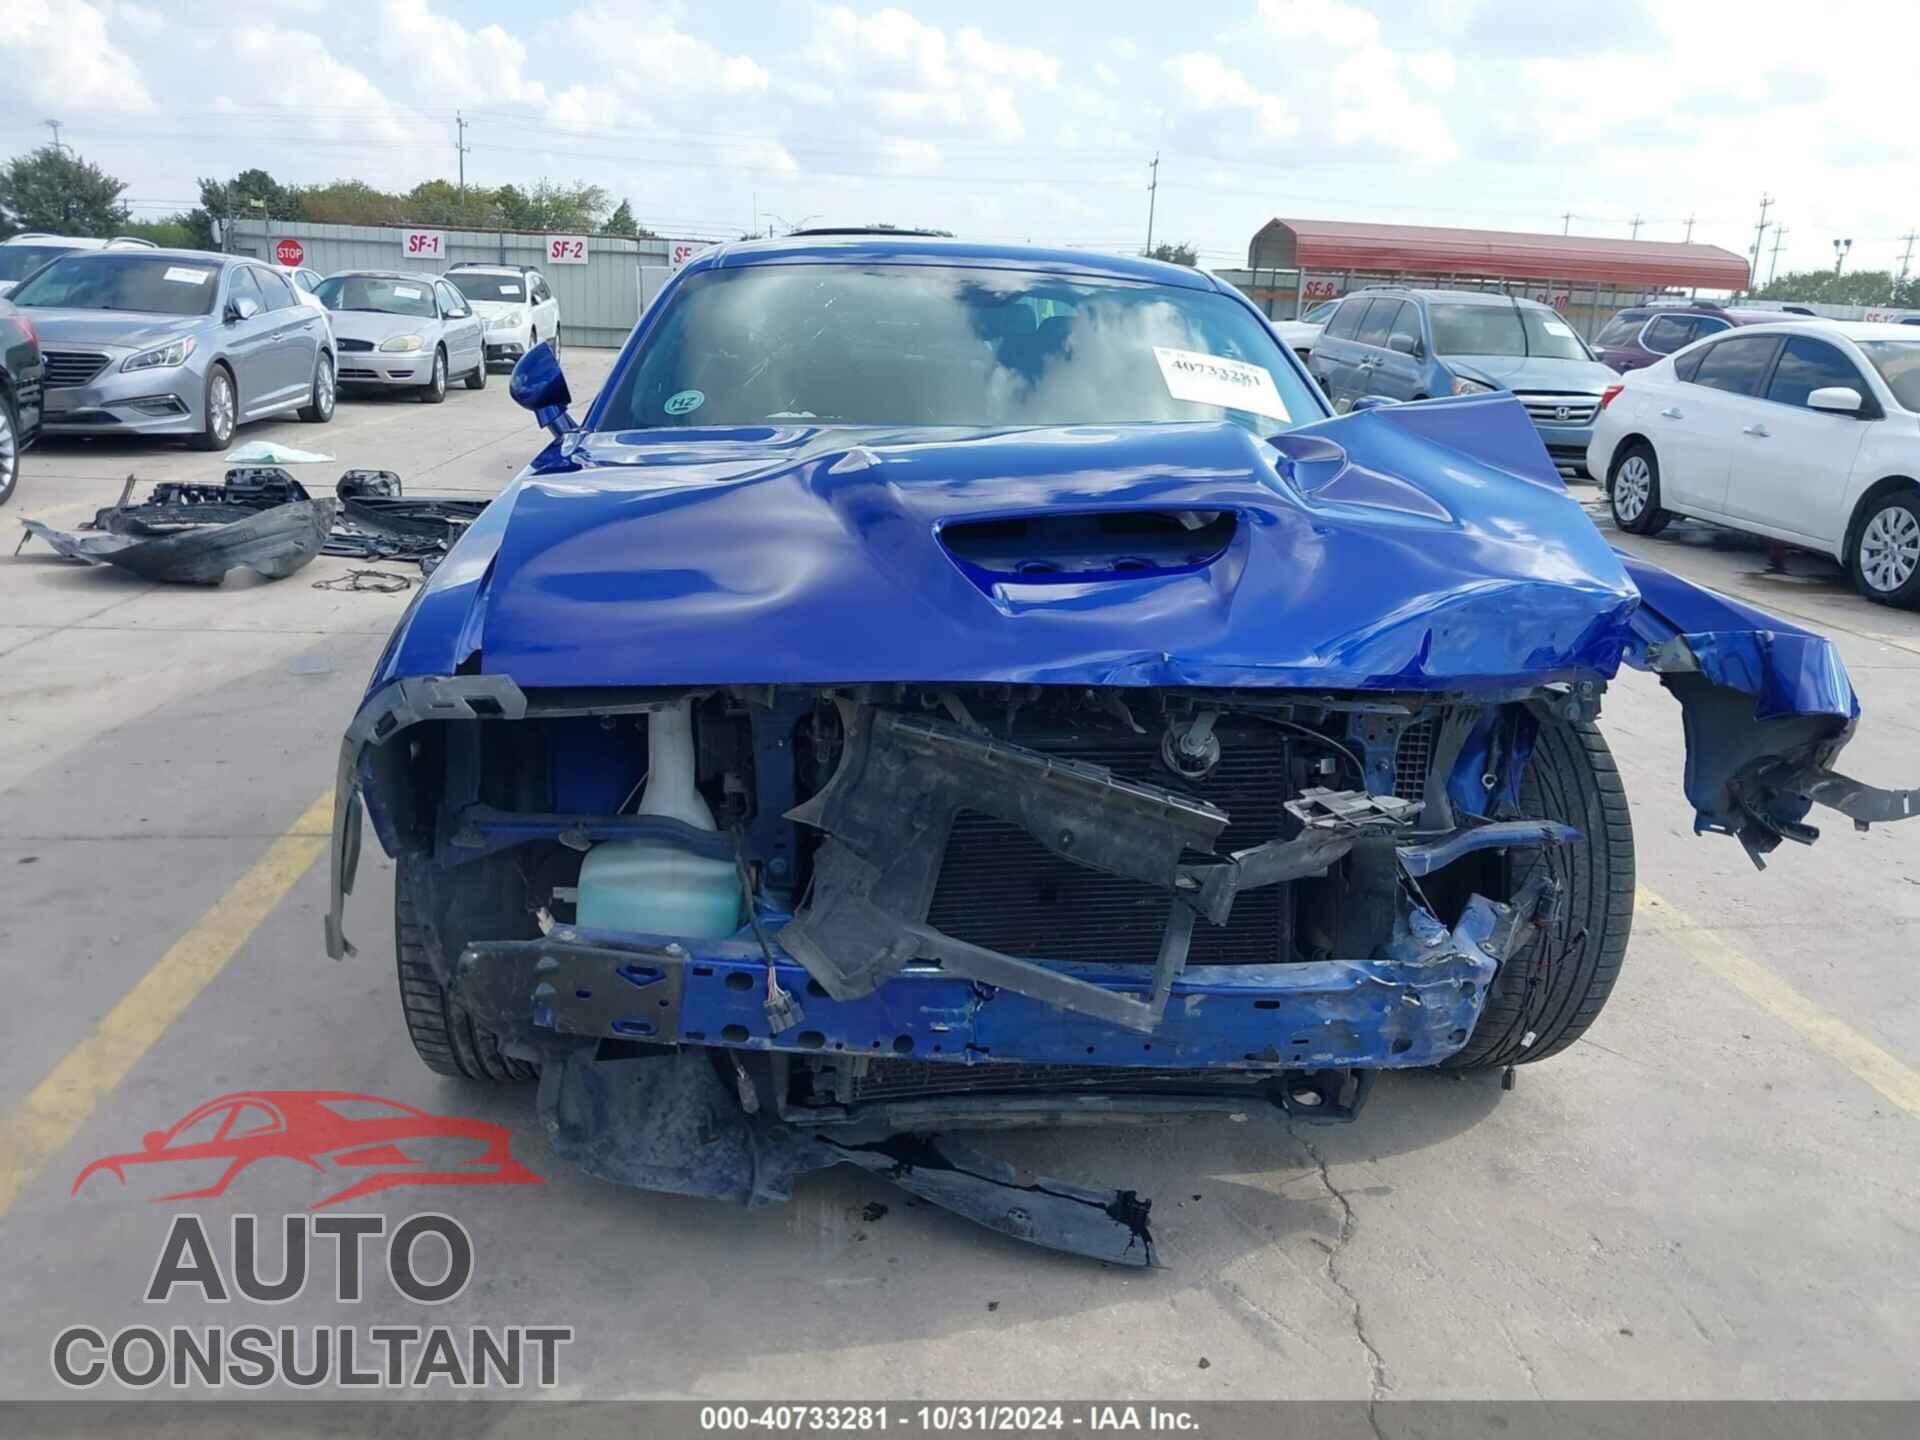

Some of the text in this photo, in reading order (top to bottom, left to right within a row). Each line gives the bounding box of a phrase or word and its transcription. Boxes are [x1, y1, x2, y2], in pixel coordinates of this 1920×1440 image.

[408, 234, 439, 253] SF-1
[551, 241, 584, 259] SF-2
[277, 247, 304, 260] STOP
[1304, 280, 1335, 298] SF-8
[1171, 359, 1261, 387] 40733281
